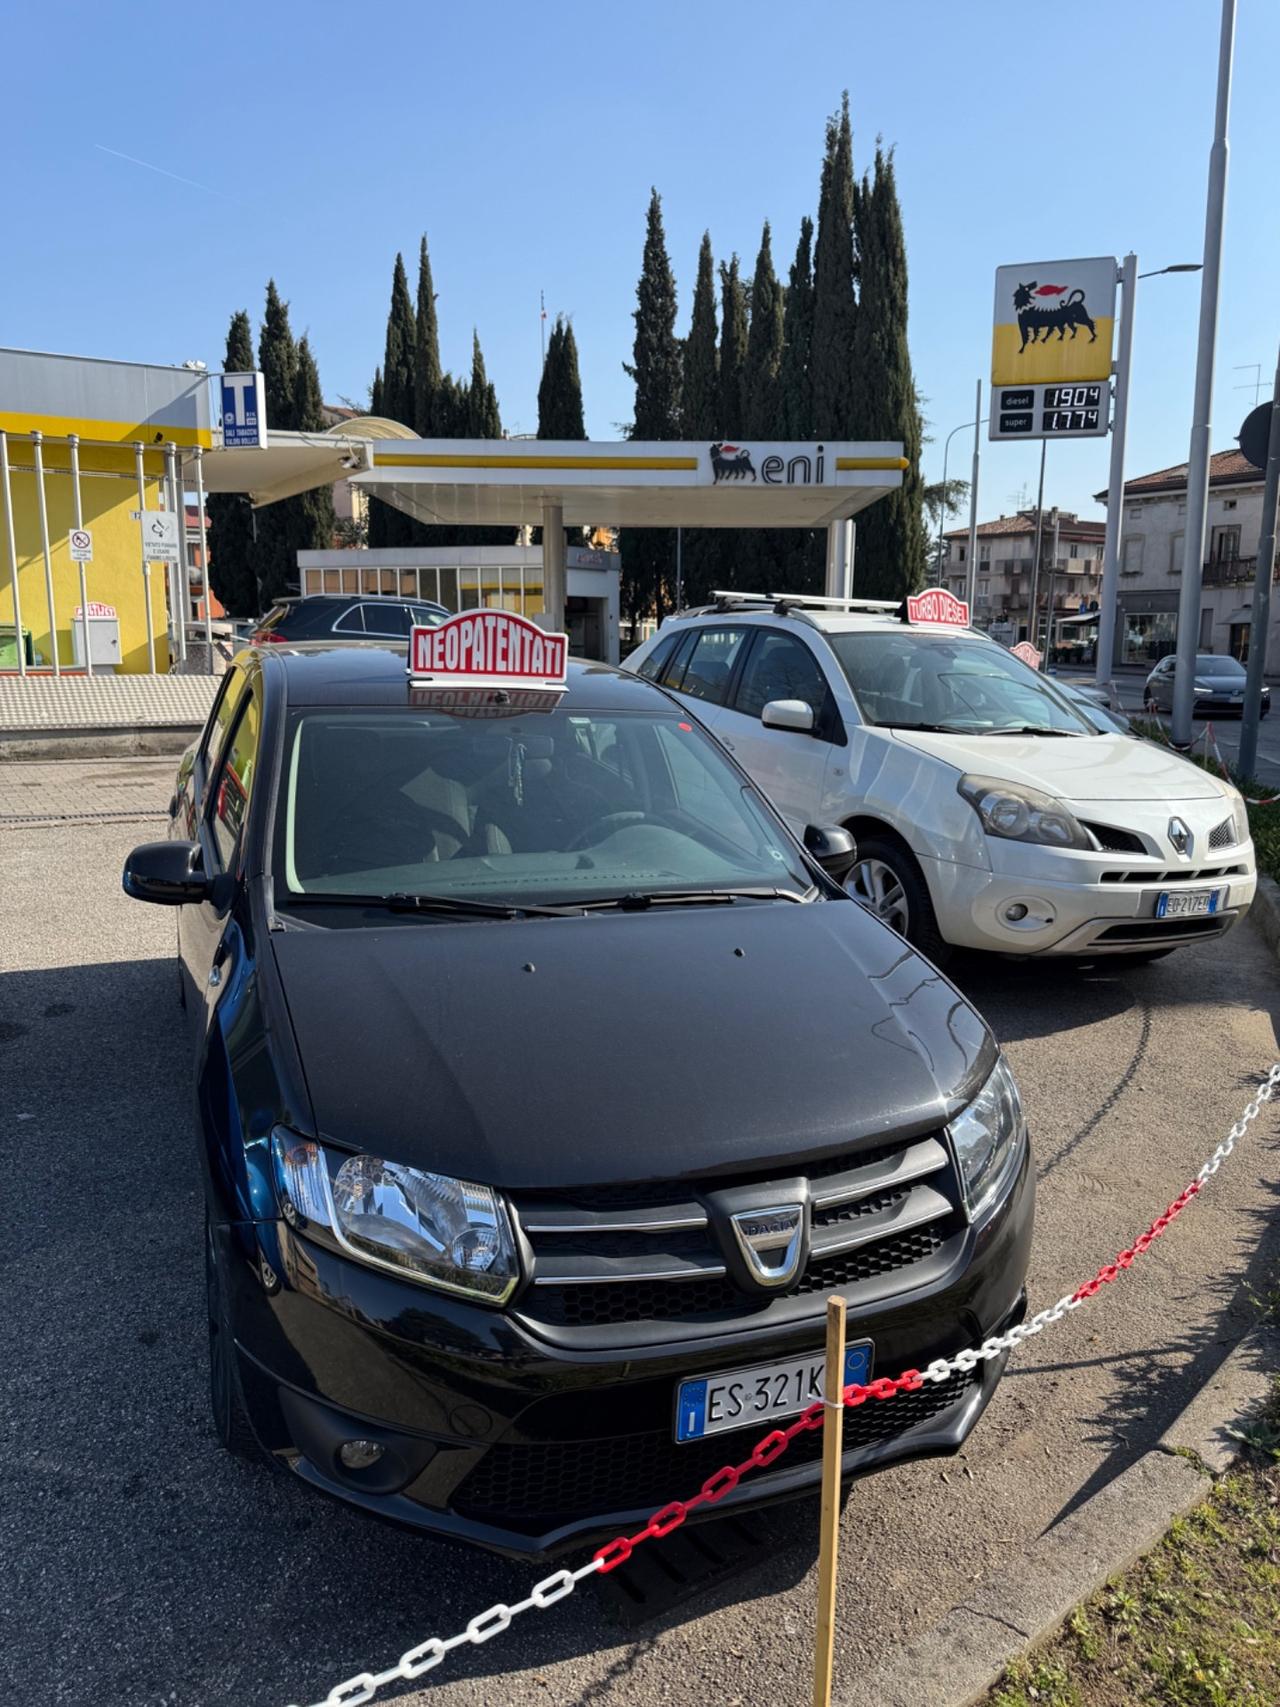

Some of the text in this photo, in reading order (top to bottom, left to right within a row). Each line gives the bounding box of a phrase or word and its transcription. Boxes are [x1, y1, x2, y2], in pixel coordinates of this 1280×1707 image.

[224, 375, 254, 426] T
[1006, 396, 1029, 405] diesel
[1005, 419, 1027, 427] super
[761, 444, 824, 484] eni
[911, 594, 967, 623] TURBO DIESEL
[418, 615, 562, 675] NEOPATENTATI
[748, 1220, 794, 1236] DACIA
